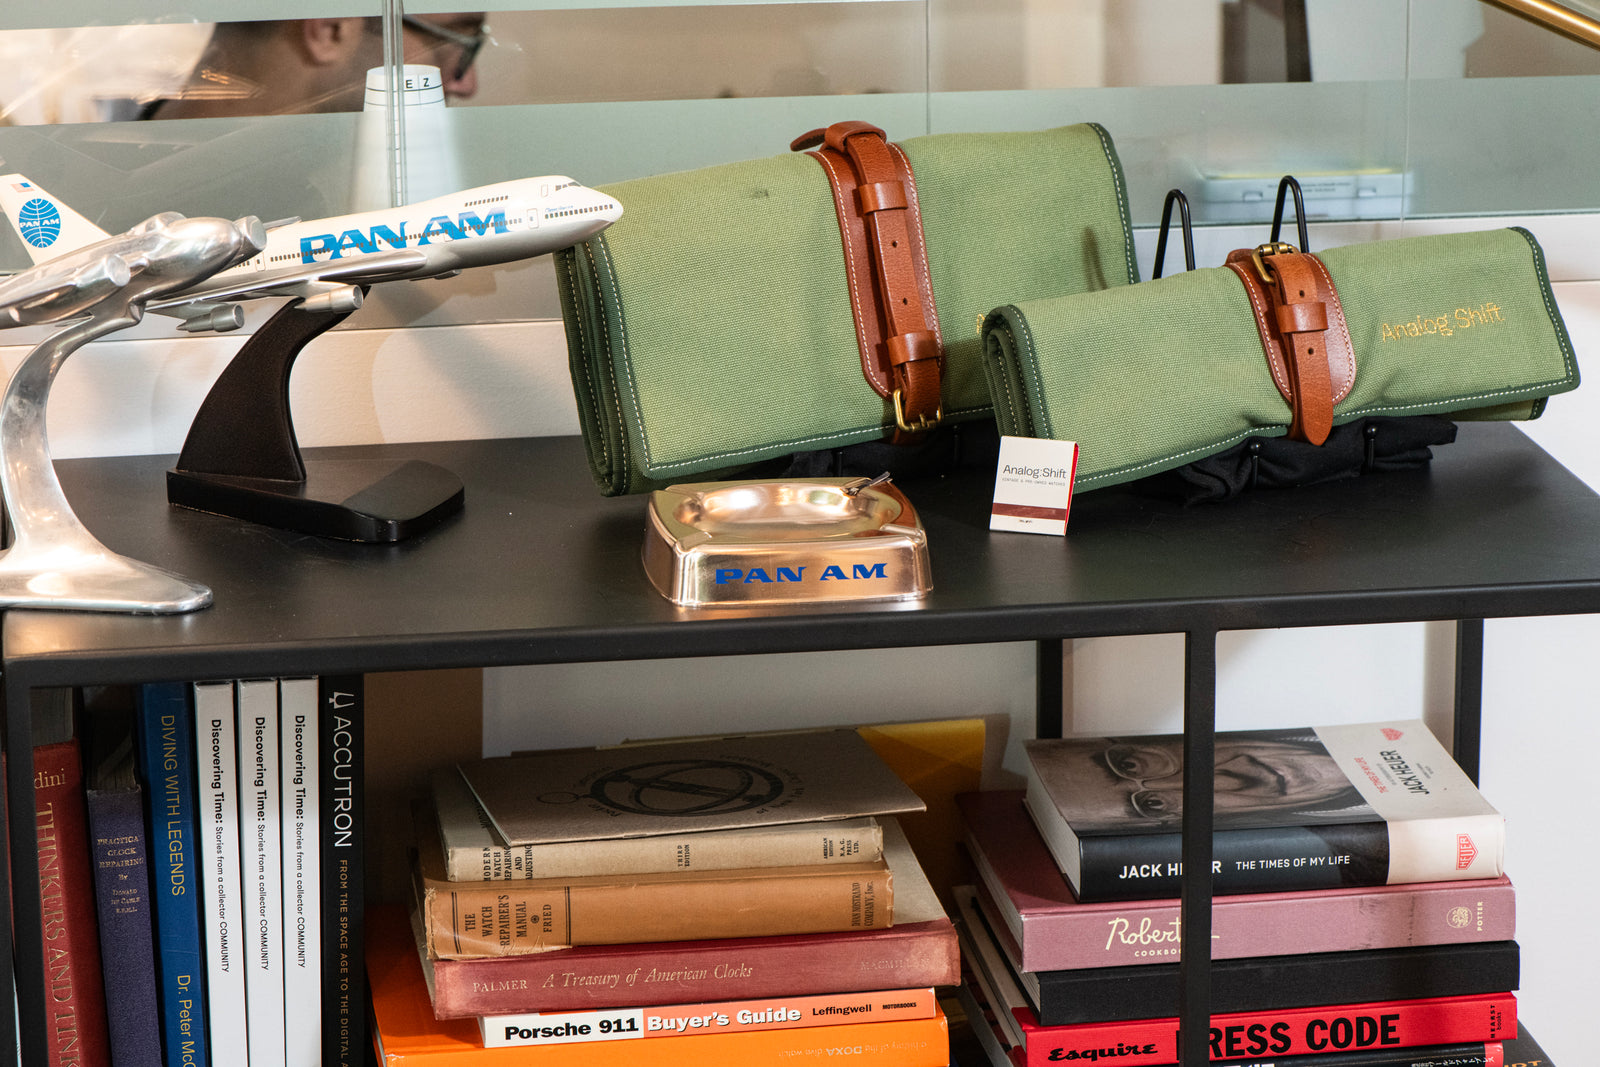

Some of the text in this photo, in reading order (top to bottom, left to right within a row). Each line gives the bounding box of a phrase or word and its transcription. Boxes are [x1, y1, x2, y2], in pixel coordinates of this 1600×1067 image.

[20, 218, 59, 228] PAN AM
[300, 207, 513, 264] PAN AM
[1382, 302, 1505, 343] Analog:Shift
[1003, 464, 1067, 479] Analog:Shift
[715, 563, 888, 585] PAN AM
[211, 719, 224, 789] Discovering
[254, 716, 267, 787] Discovering
[293, 715, 306, 785] Discovering
[1379, 750, 1414, 776] HEUER
[34, 768, 66, 789] dini
[333, 715, 353, 847] ACCUTRON
[1398, 775, 1430, 794] JACK
[161, 715, 186, 896] DIVING WITH LEGENDS
[214, 791, 225, 824] Time:
[256, 789, 267, 821] Time:
[295, 788, 306, 819] Time:
[215, 826, 224, 854] Stories
[257, 824, 266, 852] Stories
[296, 822, 305, 850] Stories
[215, 856, 224, 875] from
[258, 853, 266, 873] from
[296, 851, 305, 870] from
[493, 852, 501, 877] WATCH
[1236, 855, 1351, 871] THE TIMES OF MY LIFE
[1460, 837, 1475, 868] HEUER
[36, 802, 66, 941] THINKERS
[339, 859, 348, 889] FROM
[1119, 863, 1162, 880] JACK
[217, 884, 226, 920] collector
[258, 882, 267, 917] collector
[296, 880, 305, 915] collector
[340, 893, 348, 912] THE
[340, 915, 348, 949] SPACE
[465, 913, 476, 932] THE
[482, 906, 494, 938] WATCH
[498, 894, 511, 946] REPAIRER'S
[516, 901, 528, 938] MANUAL
[543, 904, 552, 933] FRIED
[1105, 917, 1219, 950] Robert
[219, 921, 230, 973] COMMUNITY
[259, 919, 269, 971] COMMUNITY
[297, 916, 306, 968] COMMUNITY
[1134, 948, 1181, 957] COOKBO
[47, 946, 73, 1002] AND
[340, 952, 348, 974] AGE
[473, 963, 753, 993] PALMER A Treasury of American Clocks
[177, 974, 191, 995] Dr.
[340, 976, 348, 991] TO
[179, 999, 193, 1037] Peter
[340, 995, 349, 1014] THE
[505, 1002, 917, 1041] Porsche 911 Buyer's Guide Leffingwell MOTORBOOKS
[1176, 1013, 1401, 1060] RESS CODE
[340, 1018, 349, 1058] DIGITAL
[825, 1045, 863, 1057] DOXA
[1047, 1042, 1158, 1062] Esquire
